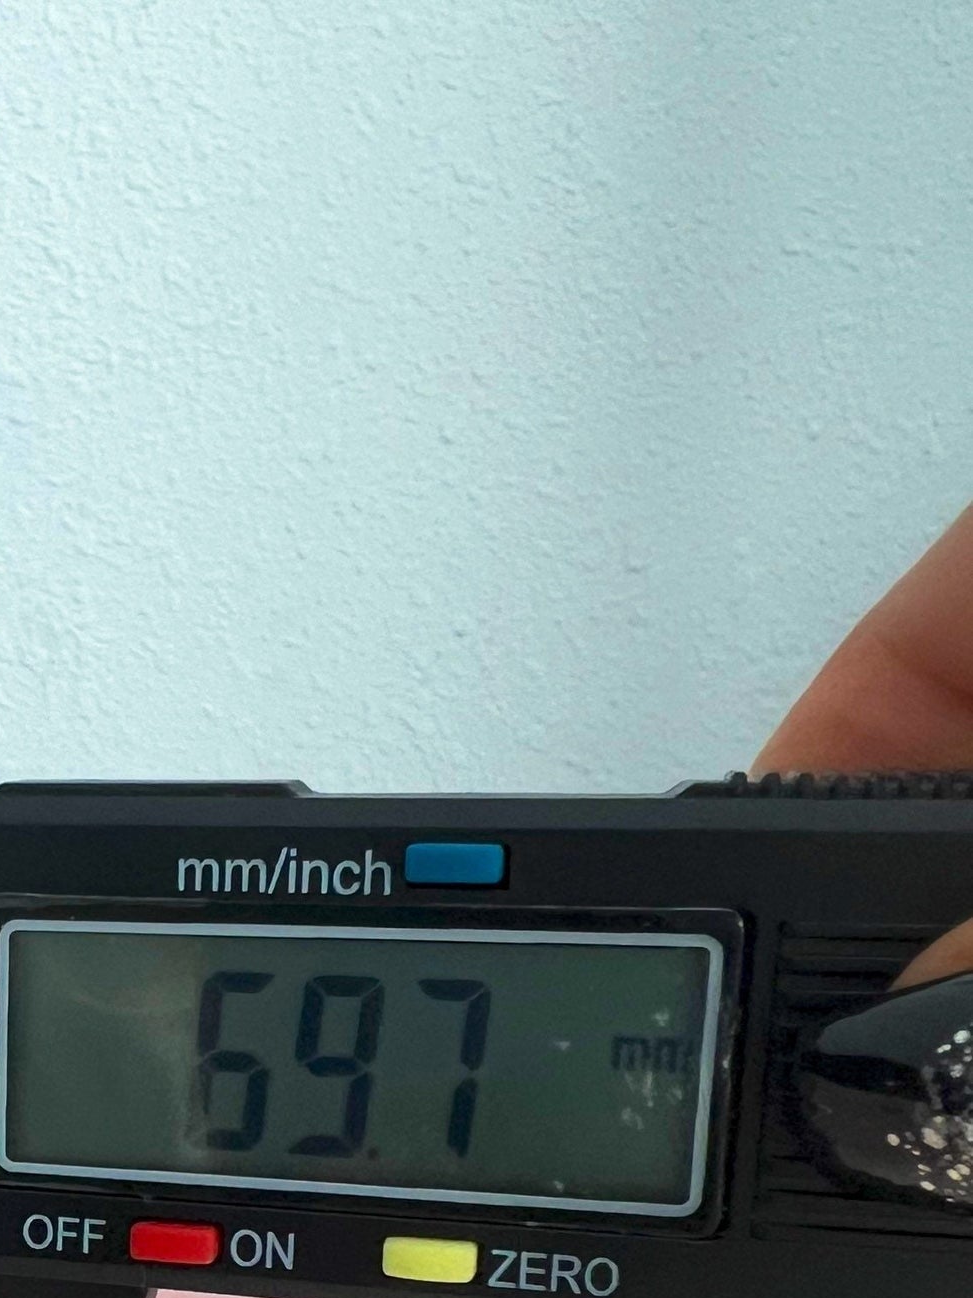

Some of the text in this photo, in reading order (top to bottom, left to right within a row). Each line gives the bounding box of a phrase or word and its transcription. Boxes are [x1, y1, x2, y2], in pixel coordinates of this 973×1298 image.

[177, 847, 392, 896] mm/inch
[22, 1214, 105, 1254] OFF
[230, 1229, 295, 1270] ON
[488, 1250, 620, 1297] ZERO
